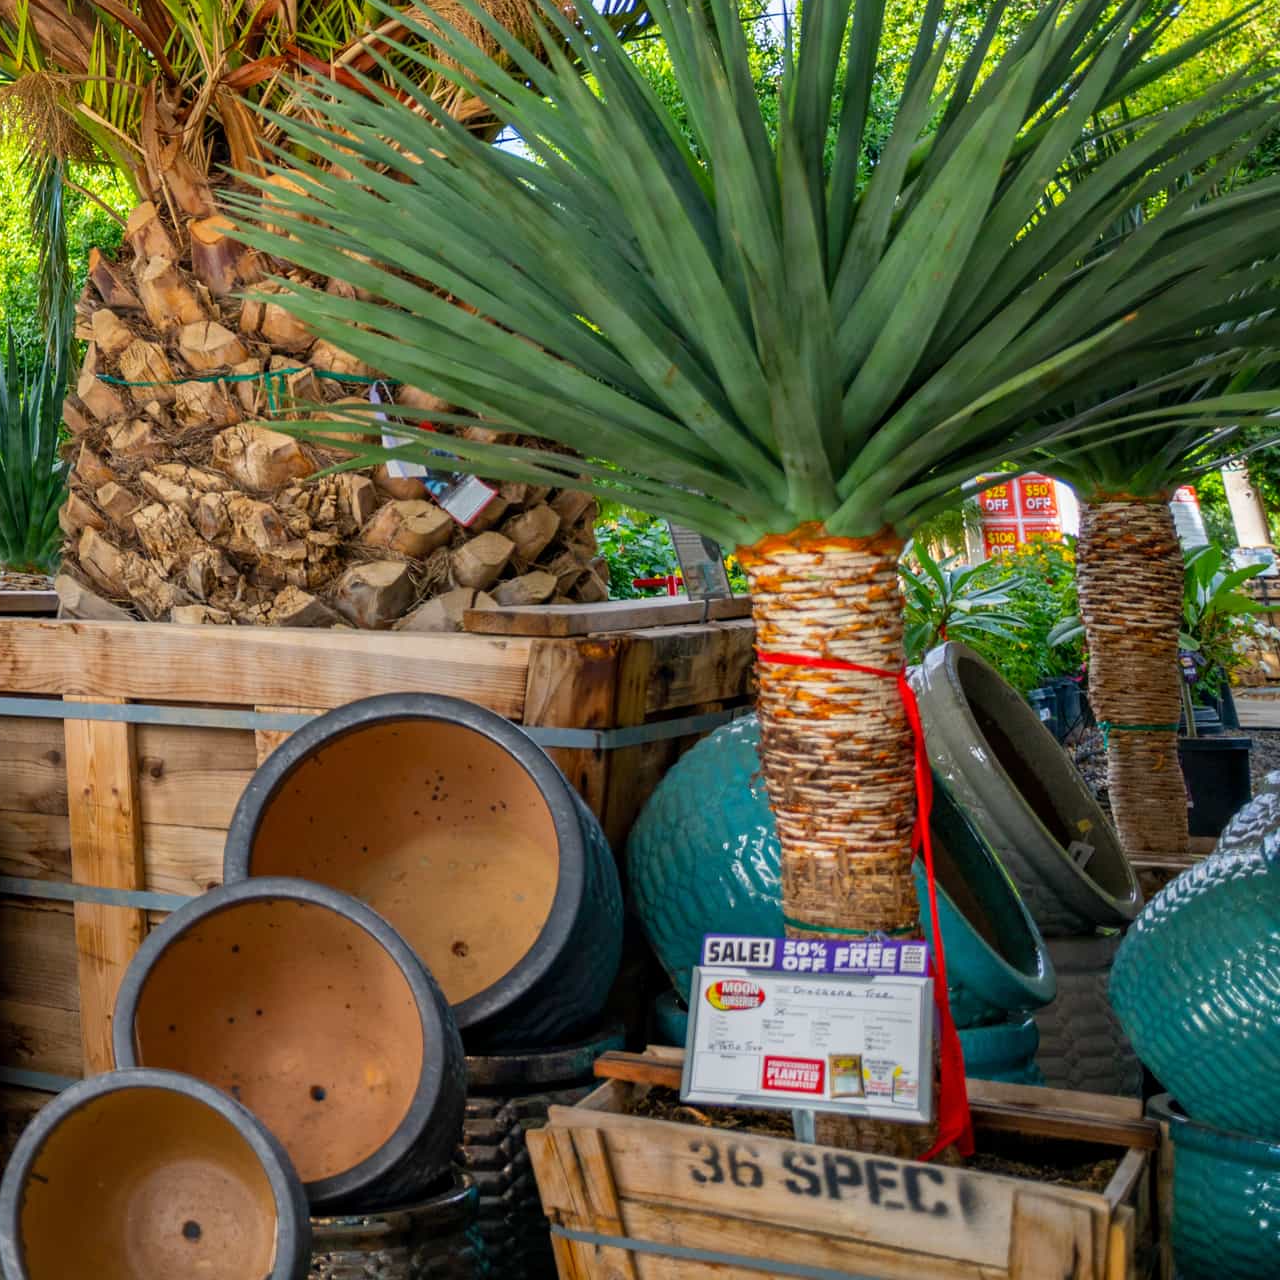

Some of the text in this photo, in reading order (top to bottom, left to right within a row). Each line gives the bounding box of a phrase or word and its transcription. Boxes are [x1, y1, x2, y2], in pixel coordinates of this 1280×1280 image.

[1025, 484, 1048, 497] $50
[985, 499, 1008, 510] OFF
[1026, 497, 1051, 509] OFF
[987, 532, 1015, 544] $100
[708, 941, 827, 963] SALE! 50%
[782, 957, 826, 971] OFF
[834, 947, 897, 968] FREE
[722, 981, 759, 995] MOON
[766, 1068, 820, 1082] PLANTED
[689, 1140, 949, 1218] 36 SPEC
